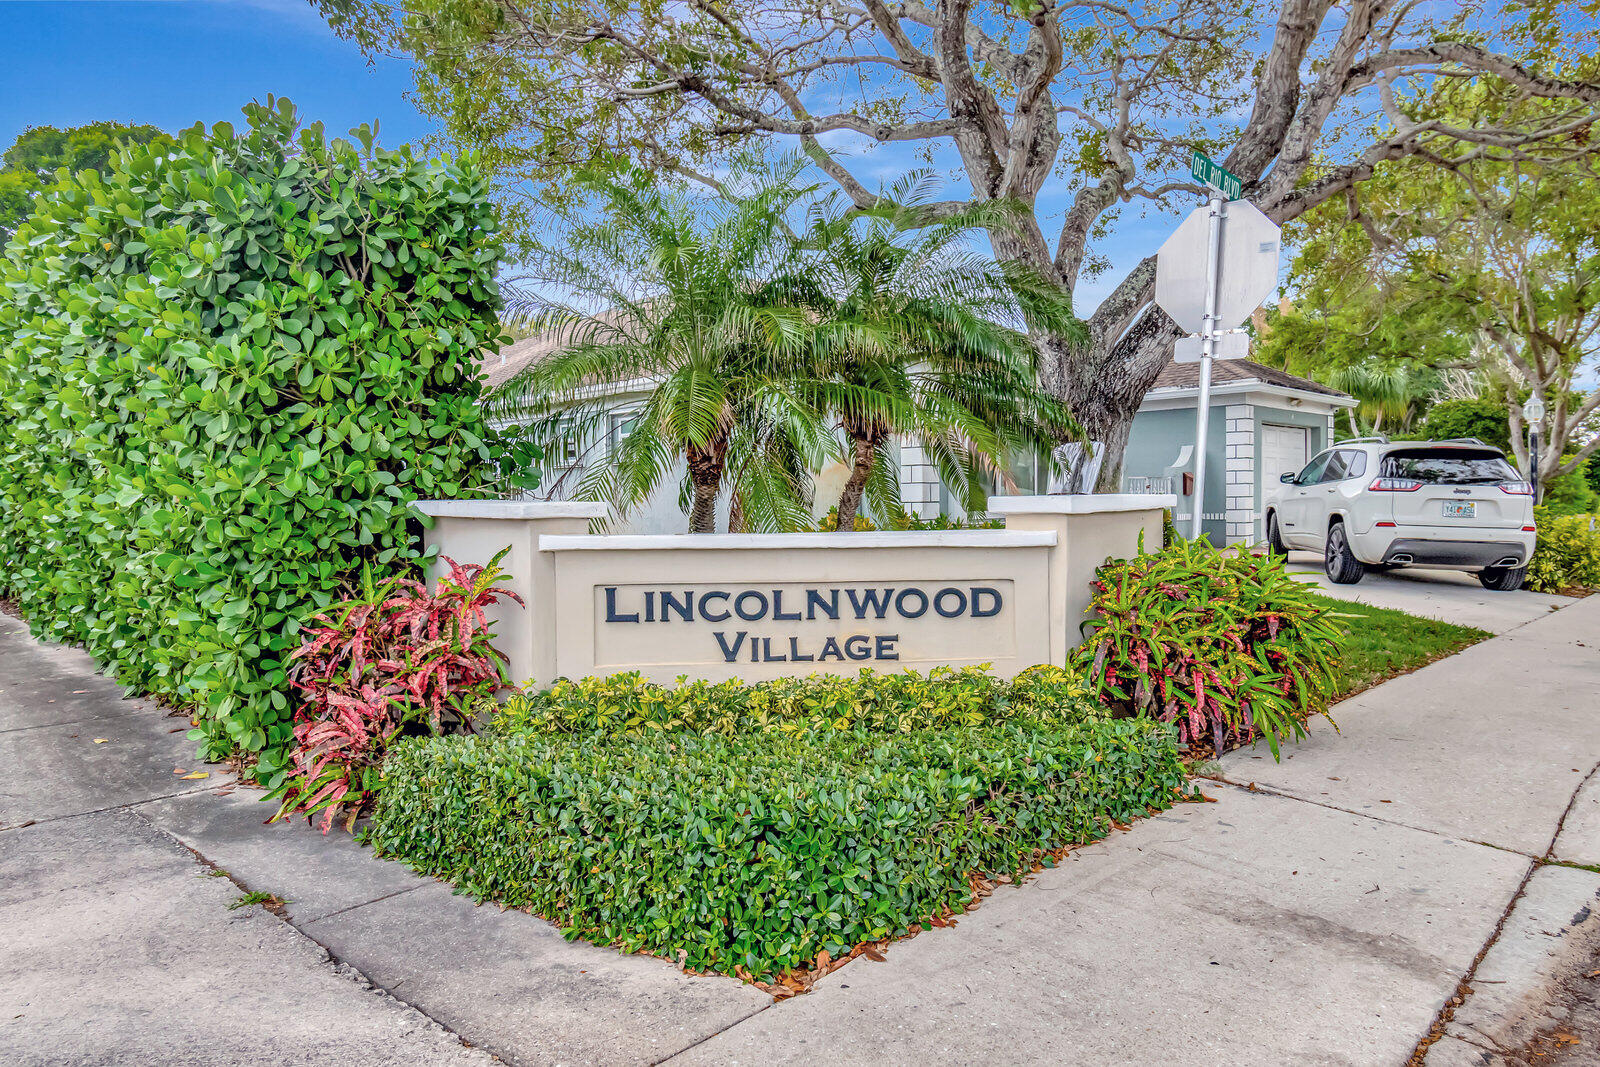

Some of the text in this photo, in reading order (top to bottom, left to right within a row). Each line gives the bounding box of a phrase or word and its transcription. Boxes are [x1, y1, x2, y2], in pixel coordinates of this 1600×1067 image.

[1193, 156, 1240, 200] DEL RIO BLVD
[1453, 487, 1472, 496] Jeep
[605, 587, 1003, 623] LINCOLNWOOD
[713, 631, 900, 662] VILLAGE
